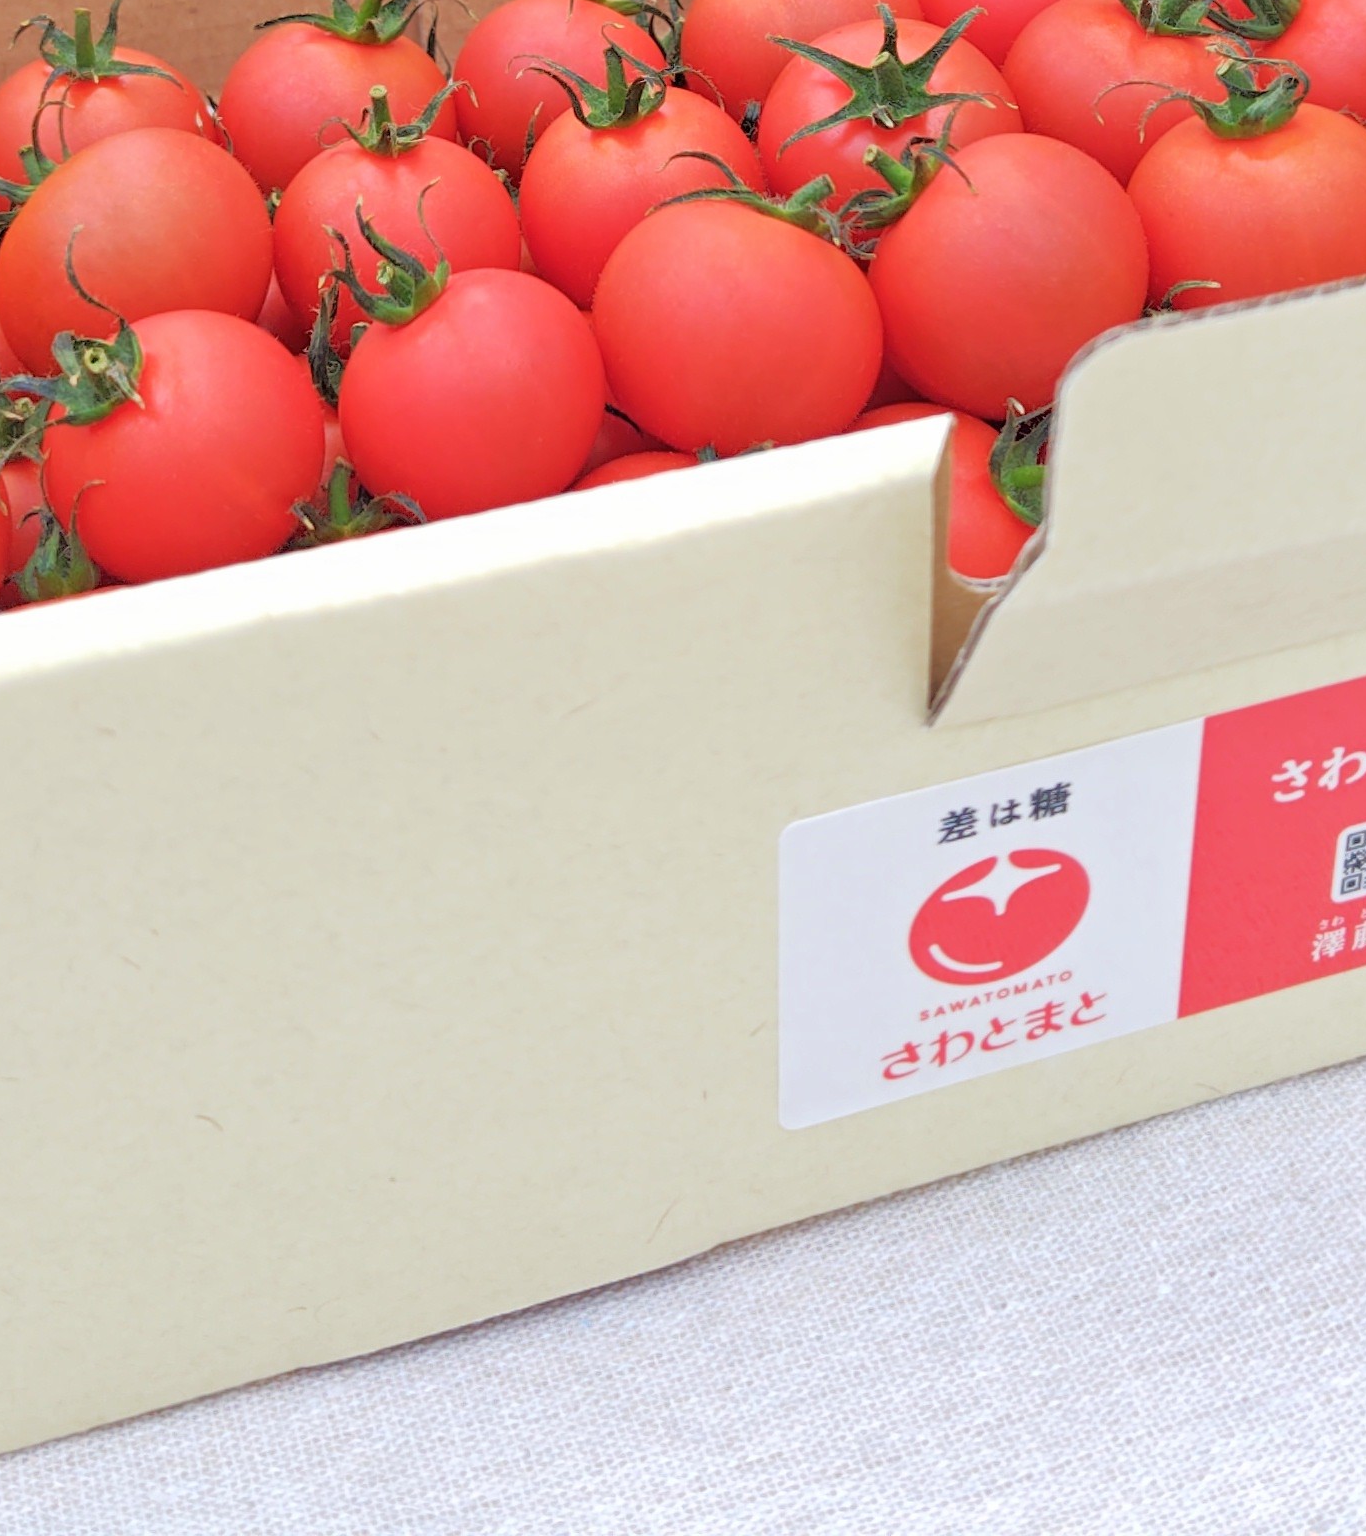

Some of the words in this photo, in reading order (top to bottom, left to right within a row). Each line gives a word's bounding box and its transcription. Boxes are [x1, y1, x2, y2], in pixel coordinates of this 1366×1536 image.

[936, 781, 1073, 845] 差は糖
[918, 968, 1074, 1023] SAWATOMATO
[879, 990, 1109, 1081] さわとまと
